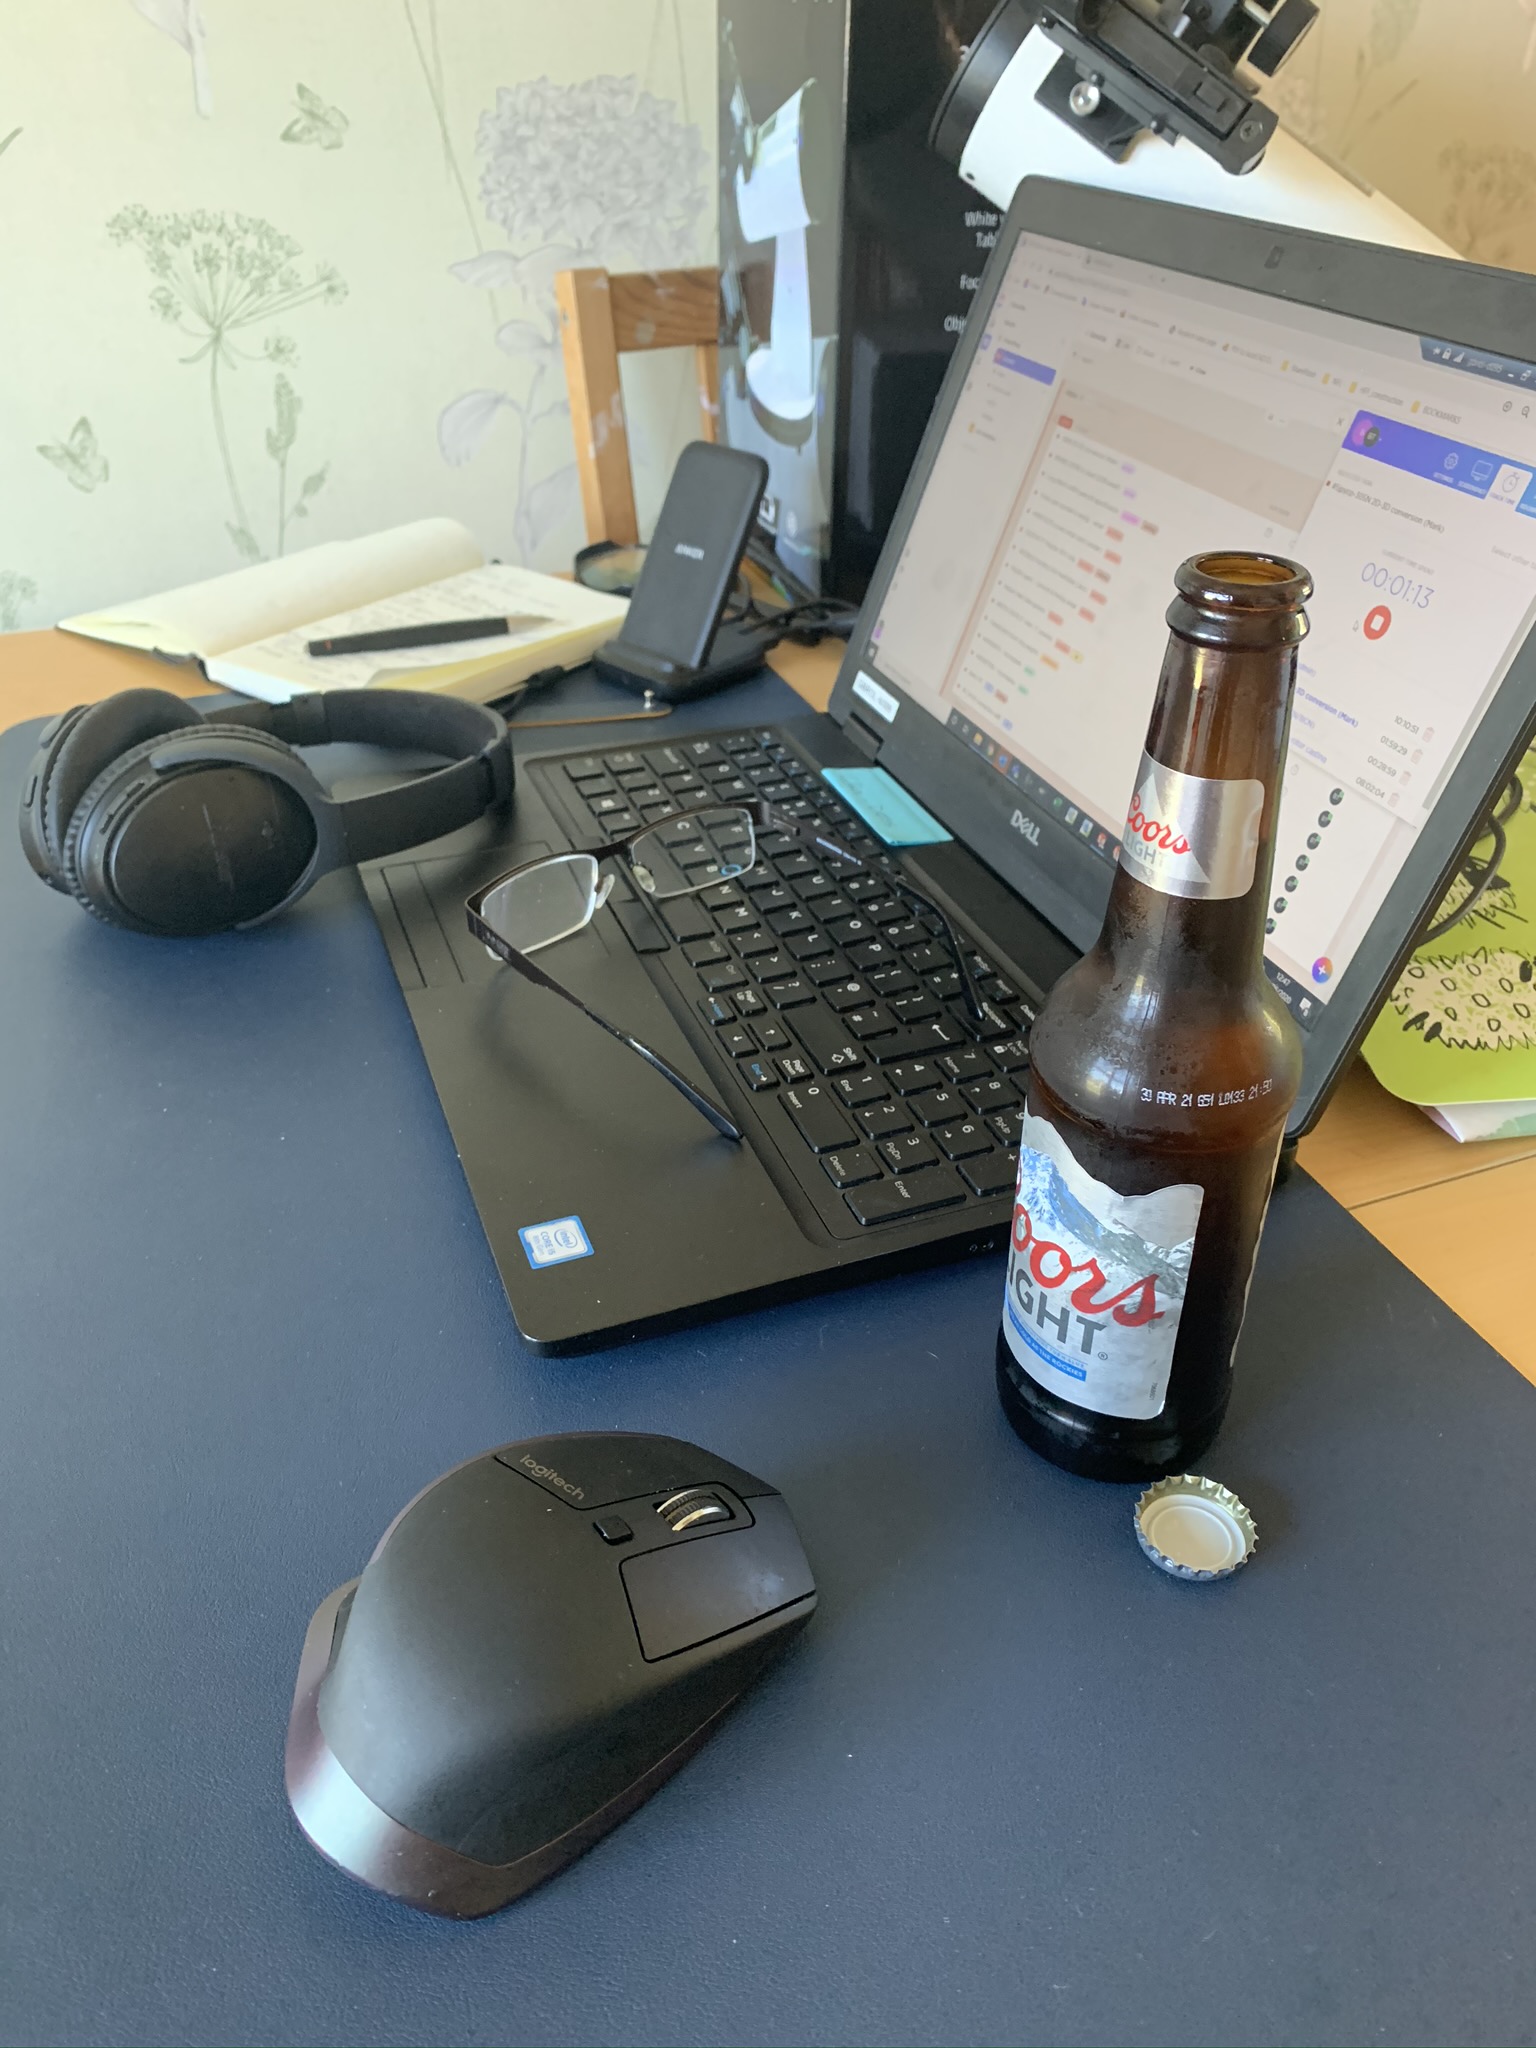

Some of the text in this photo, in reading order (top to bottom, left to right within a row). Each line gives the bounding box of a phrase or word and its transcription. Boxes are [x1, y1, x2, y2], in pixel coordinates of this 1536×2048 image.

[964, 211, 998, 227] White
[1361, 562, 1435, 608] 00:01:13
[1394, 715, 1421, 735] 10:10:51
[1380, 735, 1409, 756] 01:59:29
[1367, 755, 1397, 777] 00:28:59
[1355, 776, 1386, 799] 08:02:04
[676, 821, 690, 830] C
[1010, 809, 1041, 847] DELL
[796, 854, 808, 863] Y
[812, 875, 825, 885] U
[719, 884, 732, 895] N
[771, 888, 784, 897] J
[735, 906, 749, 918] M
[789, 910, 802, 920] K
[807, 933, 819, 943] L
[869, 943, 882, 952] P
[843, 1047, 858, 1062] Shift
[964, 1052, 976, 1060] 7
[782, 1059, 797, 1076] Down
[792, 1059, 806, 1074] Page
[914, 1064, 926, 1072] 4
[944, 1056, 960, 1074] Home
[840, 1079, 854, 1093] End
[862, 1075, 873, 1084] 1
[988, 1081, 1001, 1090] 8
[808, 1086, 820, 1096] 0
[936, 1092, 949, 1102] 5
[1156, 1090, 1178, 1106] APR
[1181, 1093, 1193, 1107] 21
[787, 1090, 803, 1109] Insert
[883, 1105, 896, 1115] 2
[962, 1124, 975, 1134] 6
[994, 1116, 1012, 1135] PgUp
[907, 1137, 920, 1147] 3
[886, 1141, 902, 1161] PgDn
[829, 1155, 847, 1177] Delete
[894, 1180, 911, 1199] Enter
[1012, 1158, 1166, 1327] oors
[1008, 1248, 1107, 1356] IGHT
[1051, 1358, 1084, 1378] ROCKIES
[518, 1454, 586, 1500] logitech
